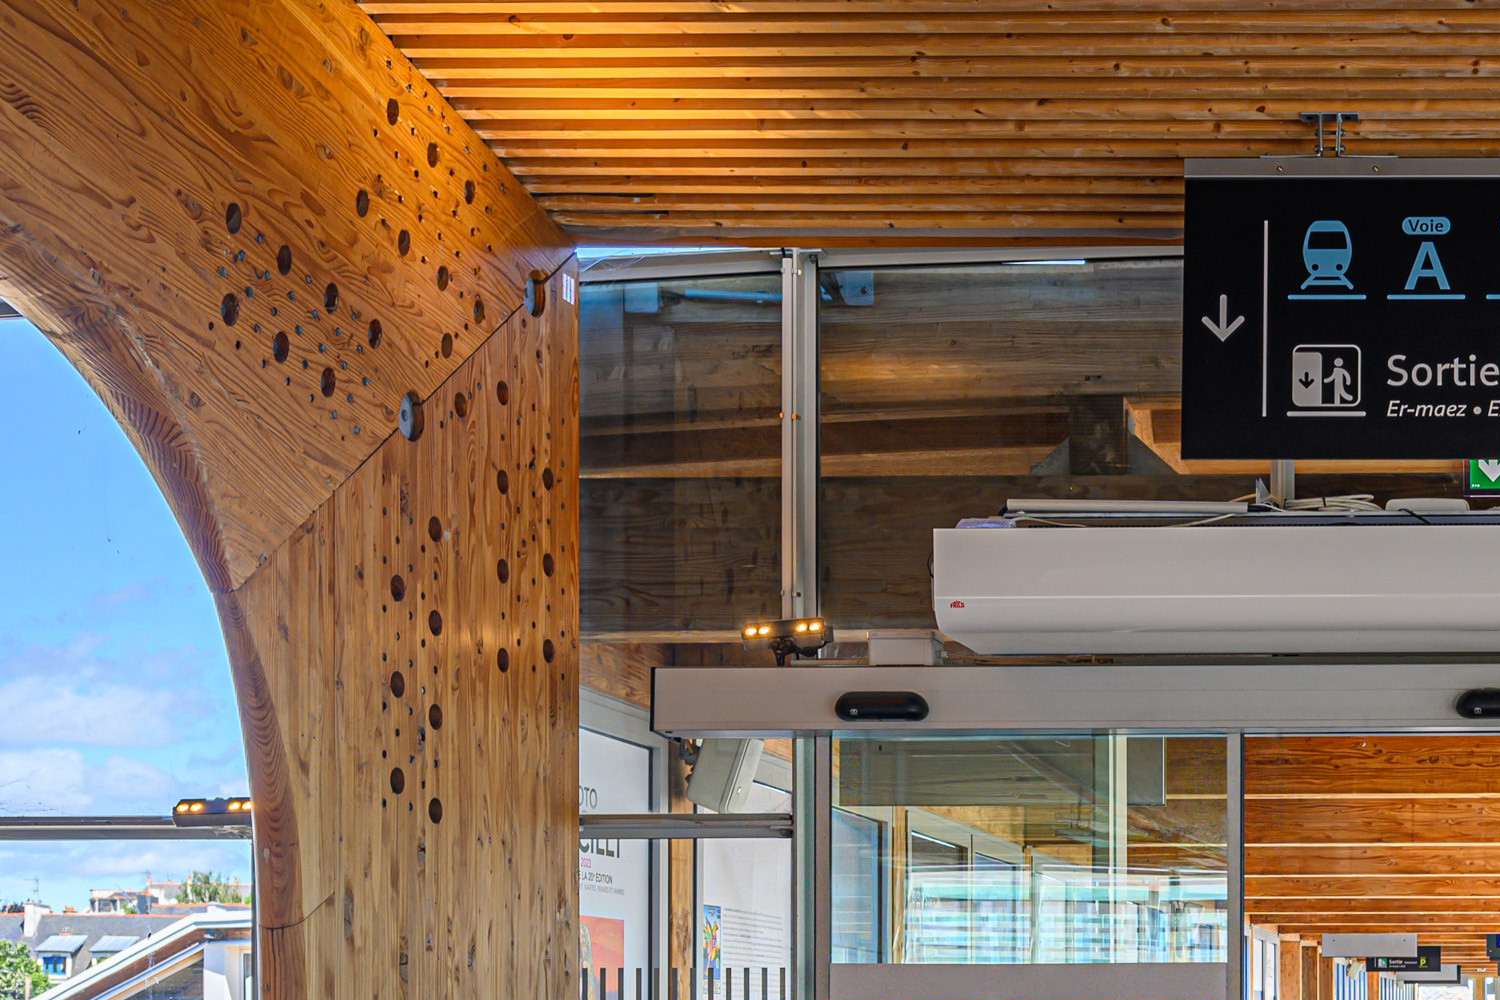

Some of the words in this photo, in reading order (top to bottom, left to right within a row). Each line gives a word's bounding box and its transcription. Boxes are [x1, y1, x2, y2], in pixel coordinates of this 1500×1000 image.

[1408, 218, 1444, 233] Voie
[1404, 241, 1450, 290] A
[1386, 354, 1500, 387] Sortie
[1386, 400, 1467, 417] Er-maez
